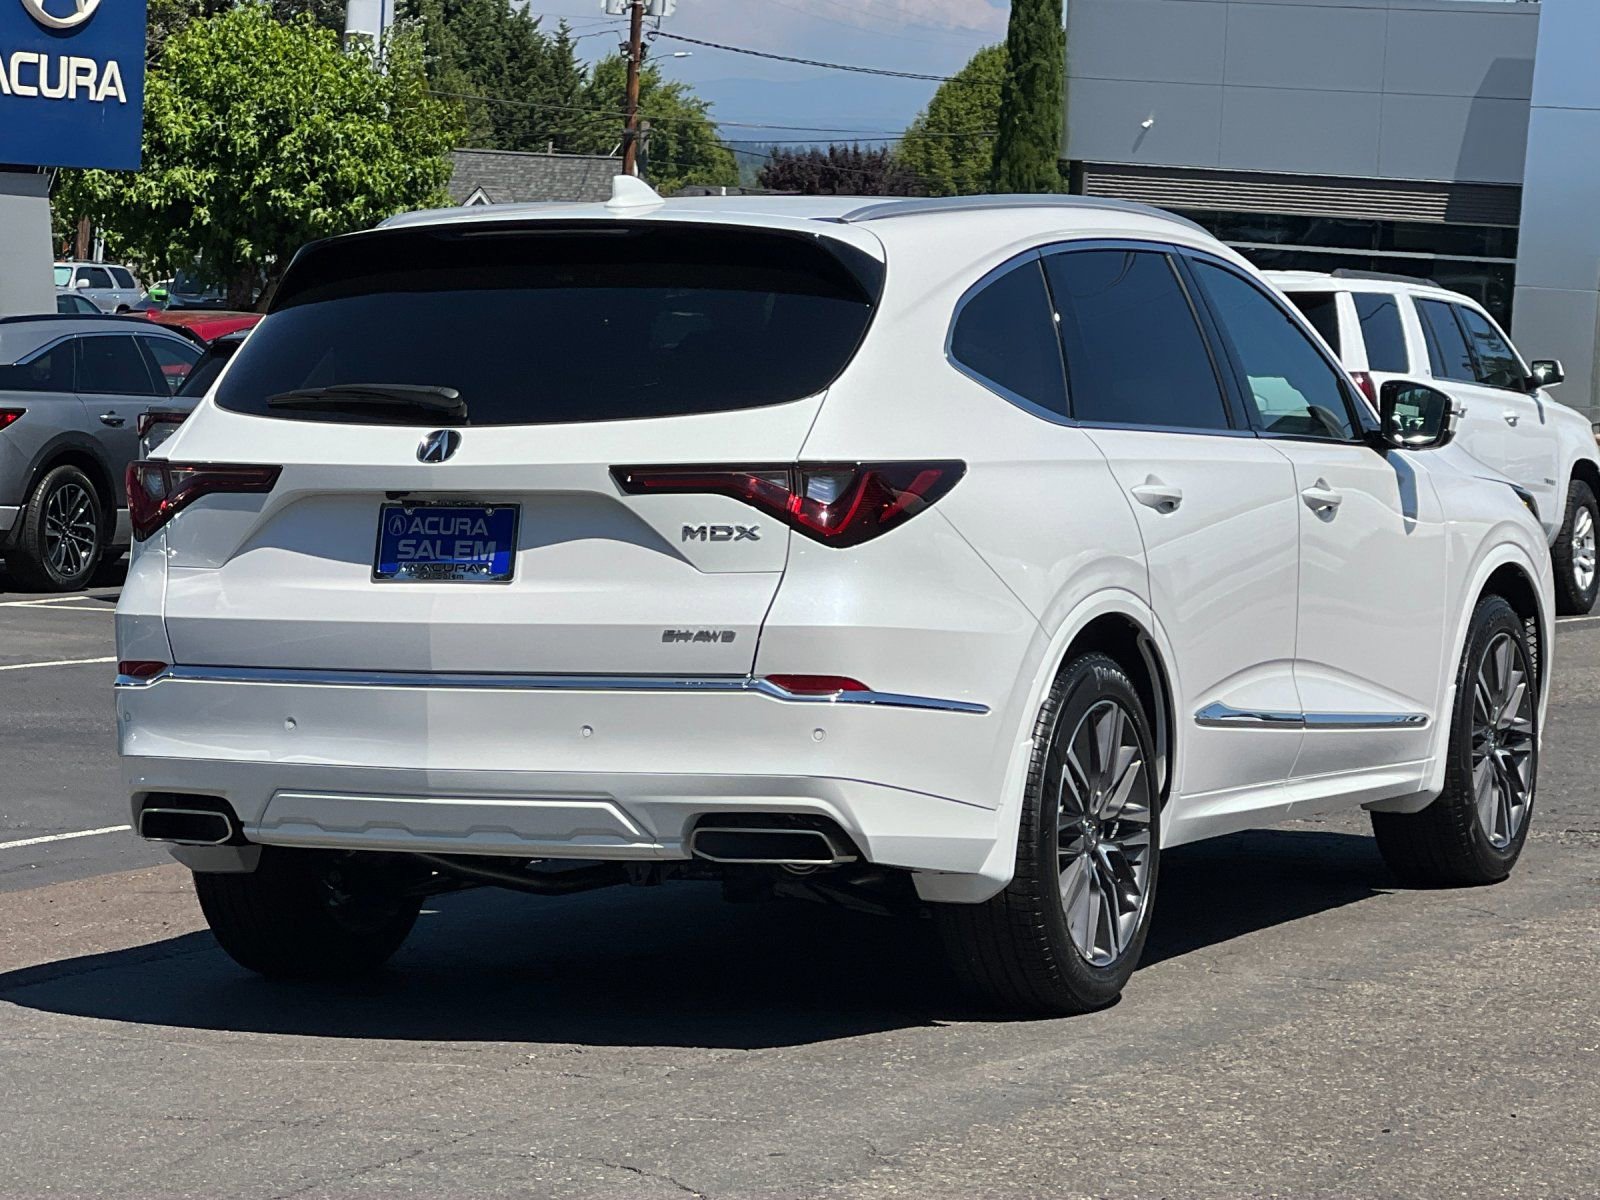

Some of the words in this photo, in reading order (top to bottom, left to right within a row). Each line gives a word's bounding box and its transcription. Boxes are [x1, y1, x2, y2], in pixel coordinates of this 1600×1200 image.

[408, 517, 488, 536] ACURA
[682, 525, 761, 542] MDX
[397, 540, 497, 561] SALEM
[418, 563, 480, 573] ACURA
